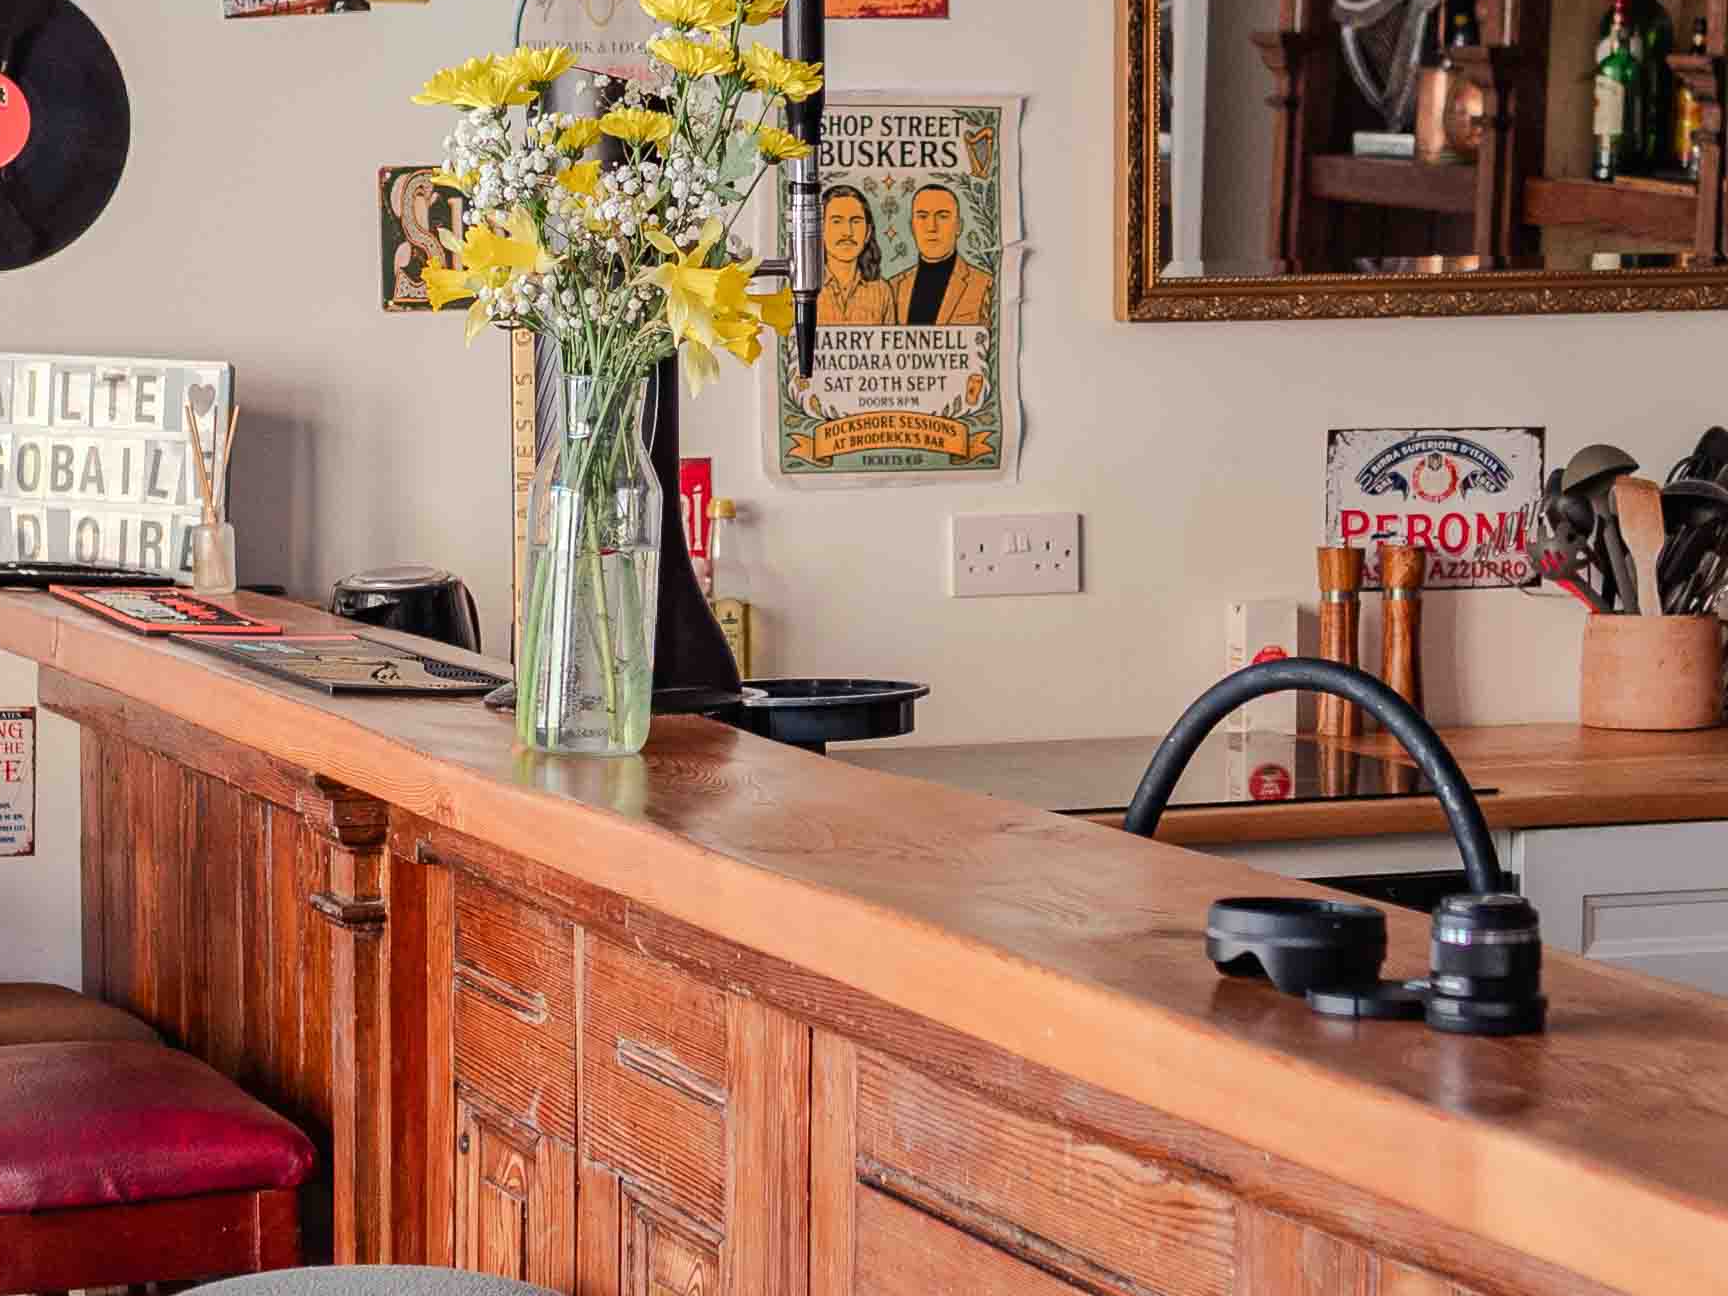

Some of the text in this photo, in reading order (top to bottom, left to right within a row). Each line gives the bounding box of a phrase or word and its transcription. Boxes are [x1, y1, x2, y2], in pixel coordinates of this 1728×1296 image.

[819, 114, 965, 138] SHOP STREET
[819, 140, 959, 169] BUSKERS
[880, 330, 968, 351] FENNELL
[814, 352, 970, 371] MACDARA O'DWYER
[824, 375, 949, 393] SAT 20TH SEPT
[858, 397, 895, 408] DOORS
[824, 415, 958, 440] ROCKSHORE SESSIONS
[832, 438, 848, 451] AT
[923, 435, 946, 449] BAR
[1370, 440, 1499, 475] BIRRA SUPERIORE D'ITALIA
[1339, 509, 1531, 555] PERONI
[1429, 559, 1528, 580] AZZURRO
